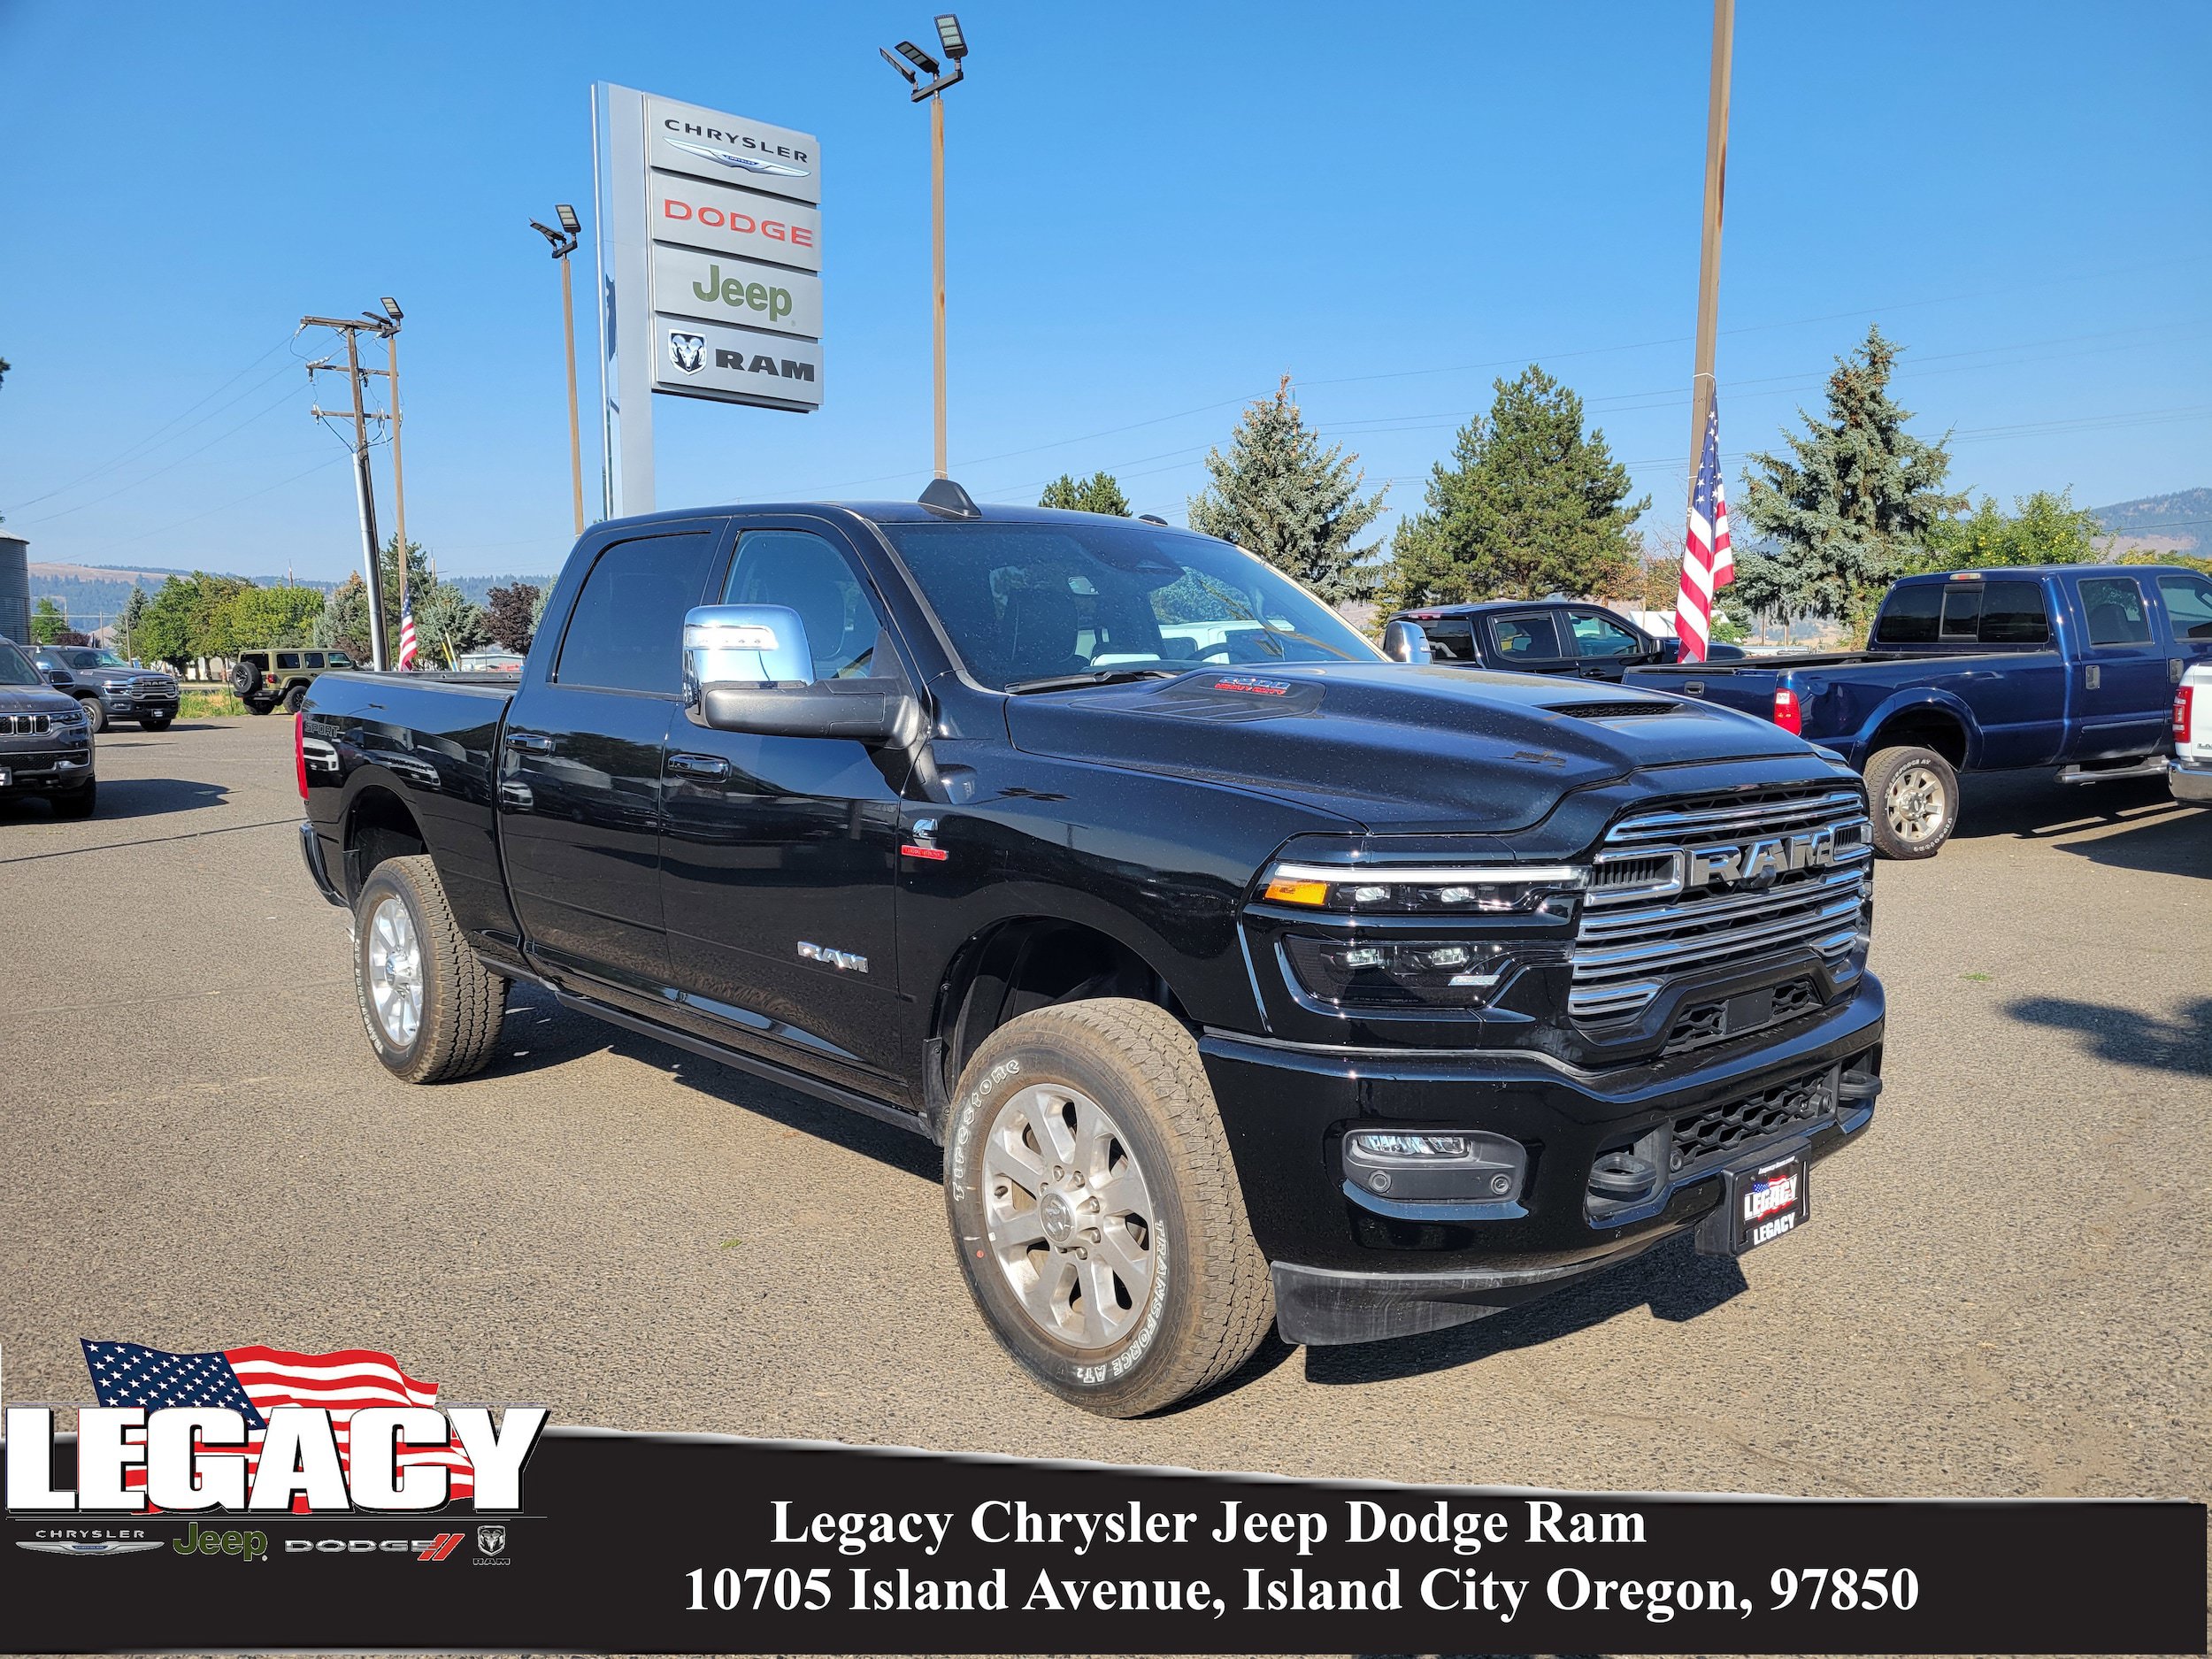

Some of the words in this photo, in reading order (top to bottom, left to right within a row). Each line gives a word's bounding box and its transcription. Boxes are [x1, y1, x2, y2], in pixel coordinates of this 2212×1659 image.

[664, 119, 808, 164] CHRYSLER
[664, 199, 813, 248] DODGE
[692, 264, 793, 322] Jeep
[715, 348, 815, 382] RAM
[304, 719, 340, 738] SPORT
[1684, 829, 1832, 887] RAM
[797, 941, 868, 973] RAM
[953, 1059, 1019, 1202] Firestone
[1744, 1177, 1797, 1220] LEGACY
[1753, 1211, 1795, 1246] LEGACY
[1111, 1219, 1168, 1377] TRANSFORCE
